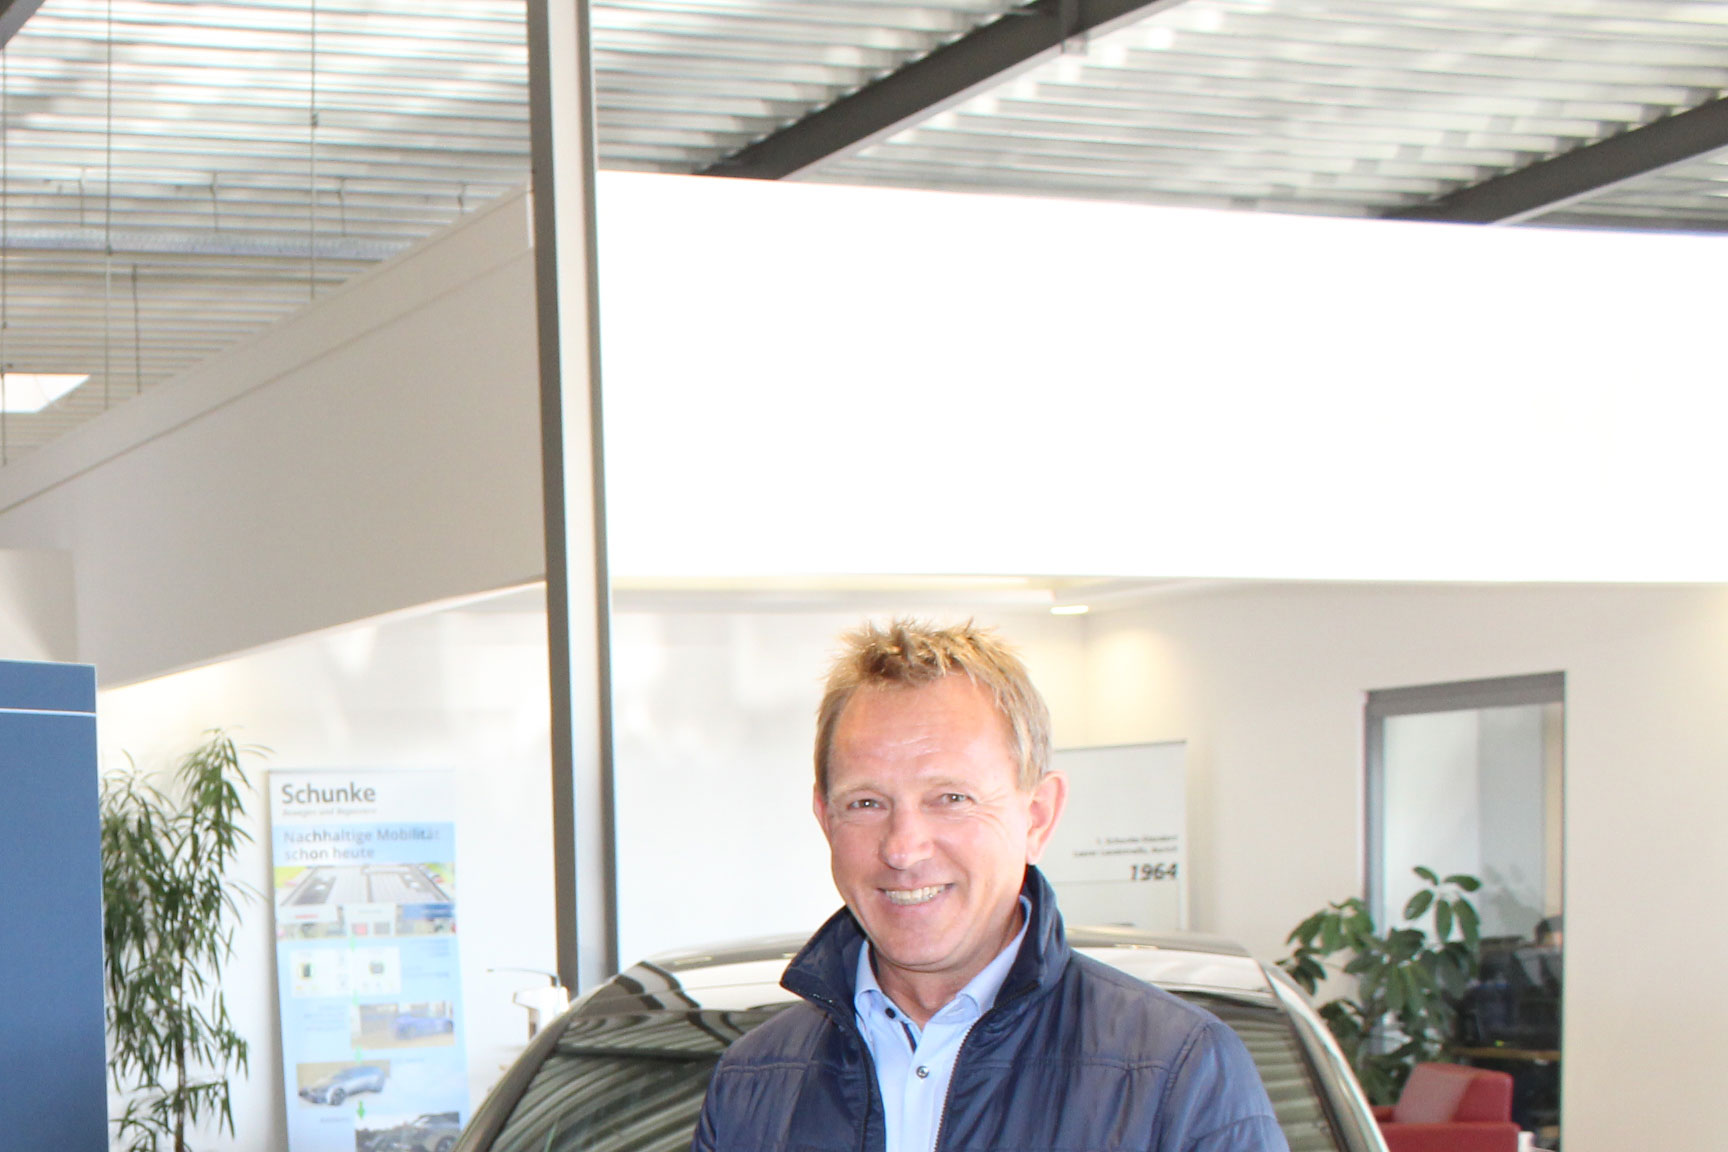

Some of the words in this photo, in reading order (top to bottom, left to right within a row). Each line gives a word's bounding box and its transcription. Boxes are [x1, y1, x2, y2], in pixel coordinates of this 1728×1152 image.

[281, 782, 377, 804] Schunke
[283, 827, 372, 845] Nachhaltige
[284, 848, 329, 861] schon
[332, 847, 375, 859] heute
[1130, 863, 1178, 881] 1964
